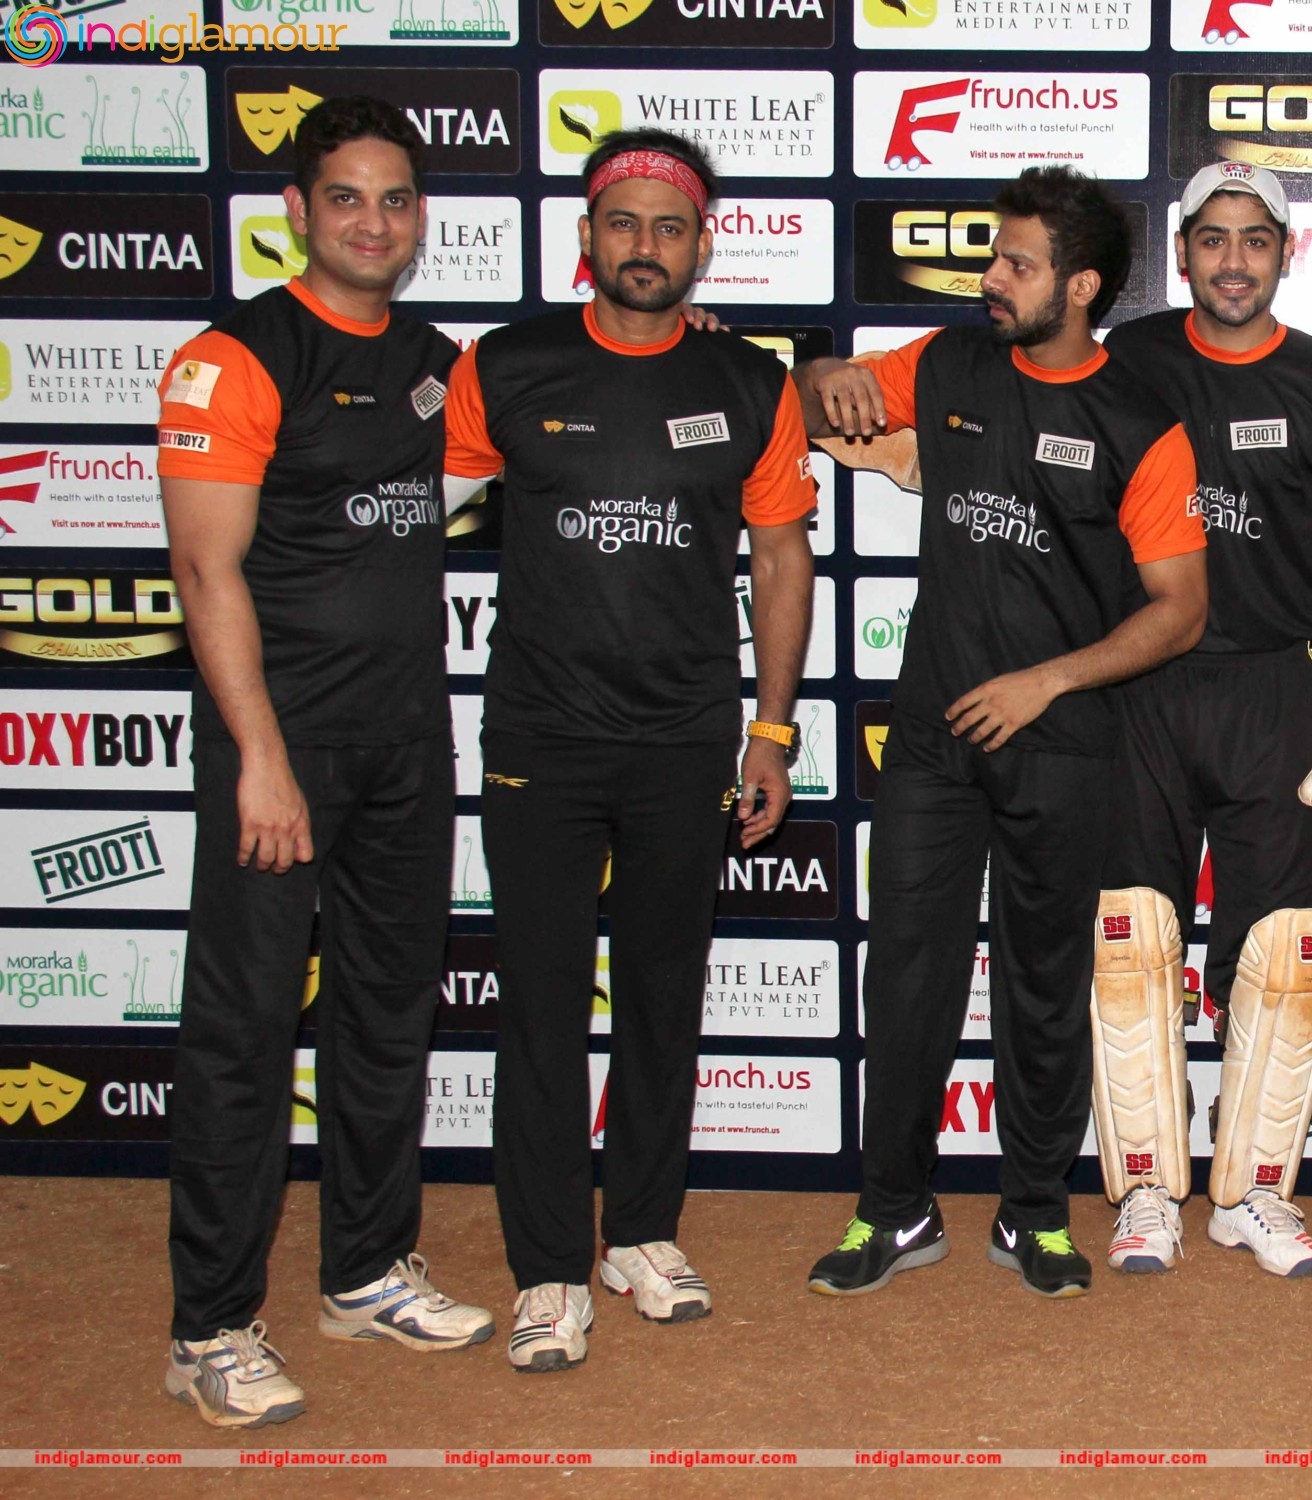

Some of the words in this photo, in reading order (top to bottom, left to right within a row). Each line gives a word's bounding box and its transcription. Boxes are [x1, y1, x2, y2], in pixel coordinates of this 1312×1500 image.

[954, 0, 1132, 14] ENTERTAINMENT
[955, 17, 1018, 29] MEDIA
[1034, 17, 1073, 30] PVT.
[1091, 18, 1130, 30] LTD.
[1288, 24, 1305, 32] Visit
[970, 79, 1119, 110] frunch.us
[637, 94, 738, 121] WHITE
[751, 95, 817, 122] LEAF
[405, 107, 511, 146] NTAA
[969, 122, 1003, 133] Health
[1005, 122, 1028, 133] with
[1031, 124, 1037, 133] a
[1040, 122, 1079, 133] tasteful
[1081, 122, 1115, 134] Punch!
[718, 143, 756, 156] PVT.
[775, 143, 813, 157] LTD.
[969, 149, 988, 159] Visit
[990, 151, 999, 160] us
[1001, 151, 1016, 160] now
[1017, 150, 1027, 160] at
[1027, 149, 1084, 161] www.frunch.us
[440, 220, 504, 247] LEAF
[58, 232, 204, 271] CINTAA
[715, 249, 723, 258] a
[725, 247, 762, 258] tasteful
[765, 247, 799, 258] Punch!
[464, 270, 502, 282] LTD.
[703, 275, 713, 284] at
[713, 274, 770, 286] www.frunch.us
[24, 343, 123, 371] WHITE
[30, 392, 91, 404] MEDIA
[106, 392, 143, 404] PVT.
[566, 422, 596, 433] CINTAA
[674, 419, 724, 441] FROOTI
[962, 421, 984, 434] CINTAA
[1235, 425, 1282, 444] FROOTI
[1042, 440, 1089, 462] FROOTI
[50, 493, 81, 503] Health
[83, 493, 104, 503] with
[107, 494, 114, 503] a
[117, 492, 153, 504] tasteful
[588, 495, 662, 517] Morarka
[967, 488, 1027, 519] Morarka
[51, 519, 70, 528] Visit
[71, 520, 81, 528] us
[83, 520, 96, 528] now
[97, 520, 106, 528] at
[106, 519, 161, 529] www.frunch.us
[556, 507, 692, 554] Organic
[946, 493, 1052, 553] Organic
[33, 829, 163, 896] FROOTI
[727, 857, 829, 892] NTAA
[1103, 915, 1131, 933] SS
[6, 951, 73, 970] Morarka
[760, 961, 822, 986] LEAF
[728, 1006, 765, 1017] PVT.
[783, 1006, 820, 1018] LTD.
[705, 1101, 726, 1110] with
[738, 1101, 772, 1110] tasteful
[777, 1101, 808, 1111] Punch!
[435, 1117, 472, 1129] PVT.
[727, 1125, 781, 1135] www.frunch.us
[1125, 1152, 1154, 1171] SS
[1255, 1164, 1284, 1180] SS
